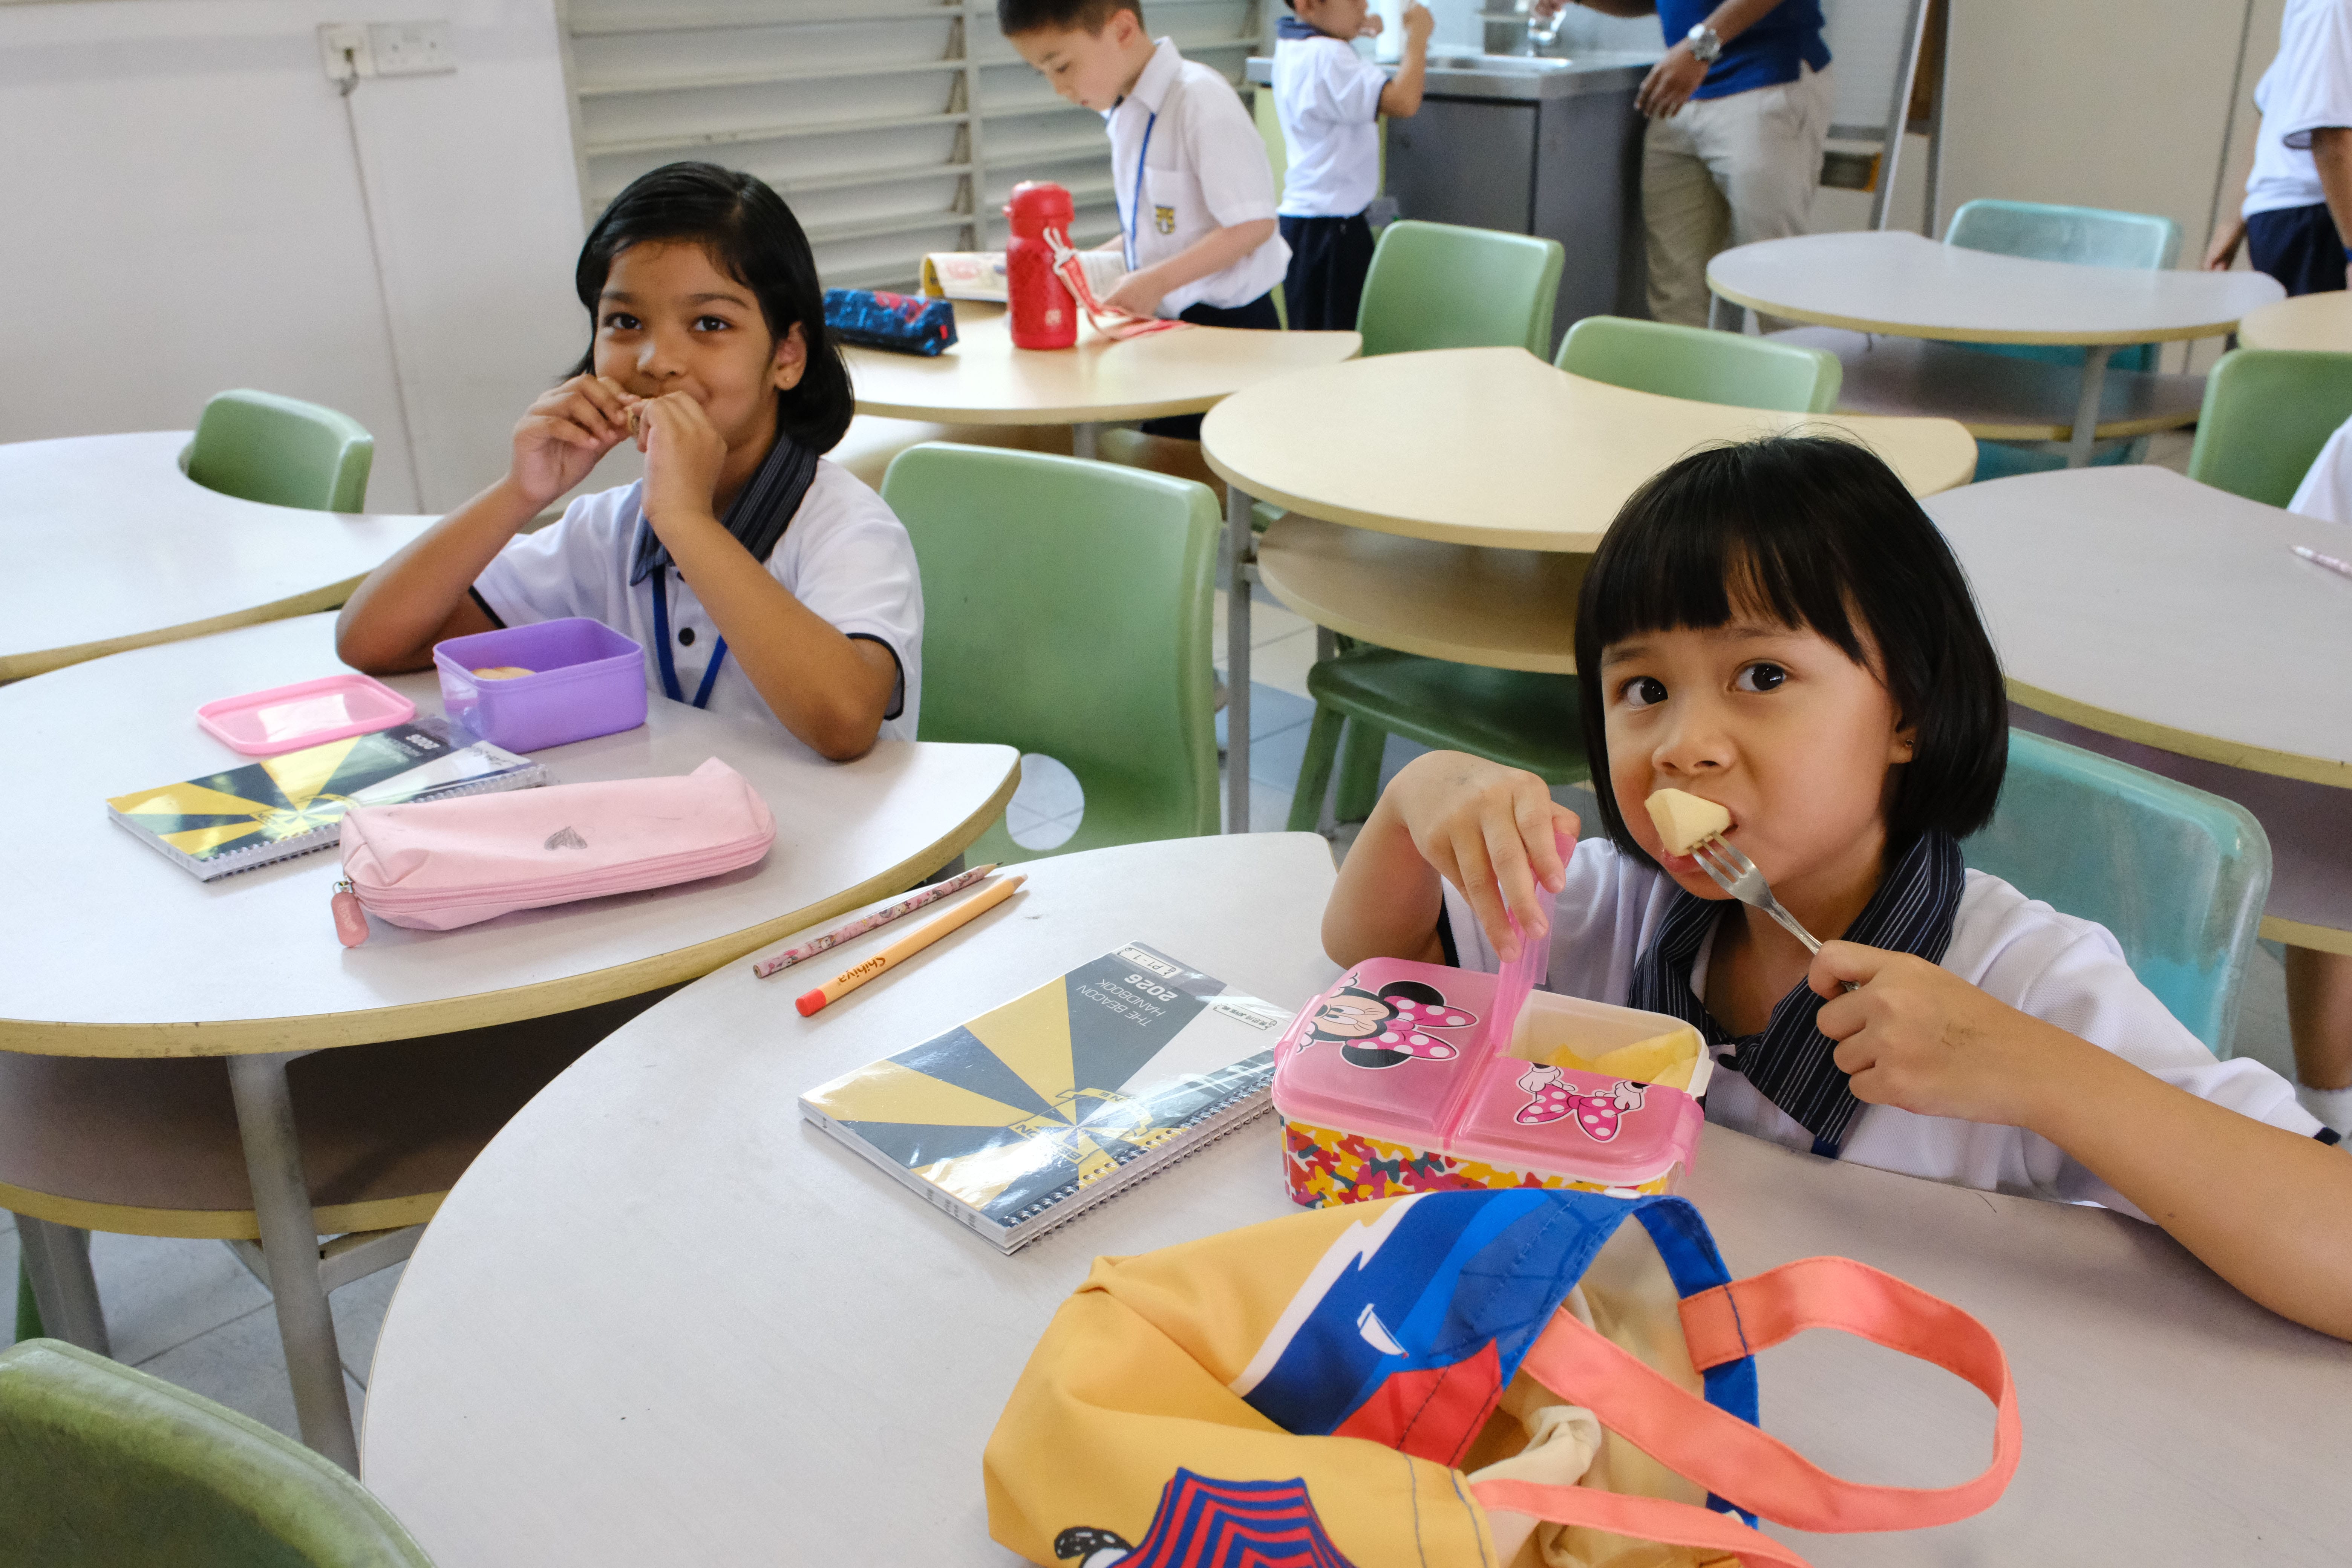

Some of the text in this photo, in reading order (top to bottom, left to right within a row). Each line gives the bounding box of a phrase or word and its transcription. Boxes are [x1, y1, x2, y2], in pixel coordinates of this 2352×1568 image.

[1076, 985, 1152, 1027] THE BEACON
[1095, 979, 1166, 1017] HANDBOOK
[1124, 974, 1178, 1001] 2026
